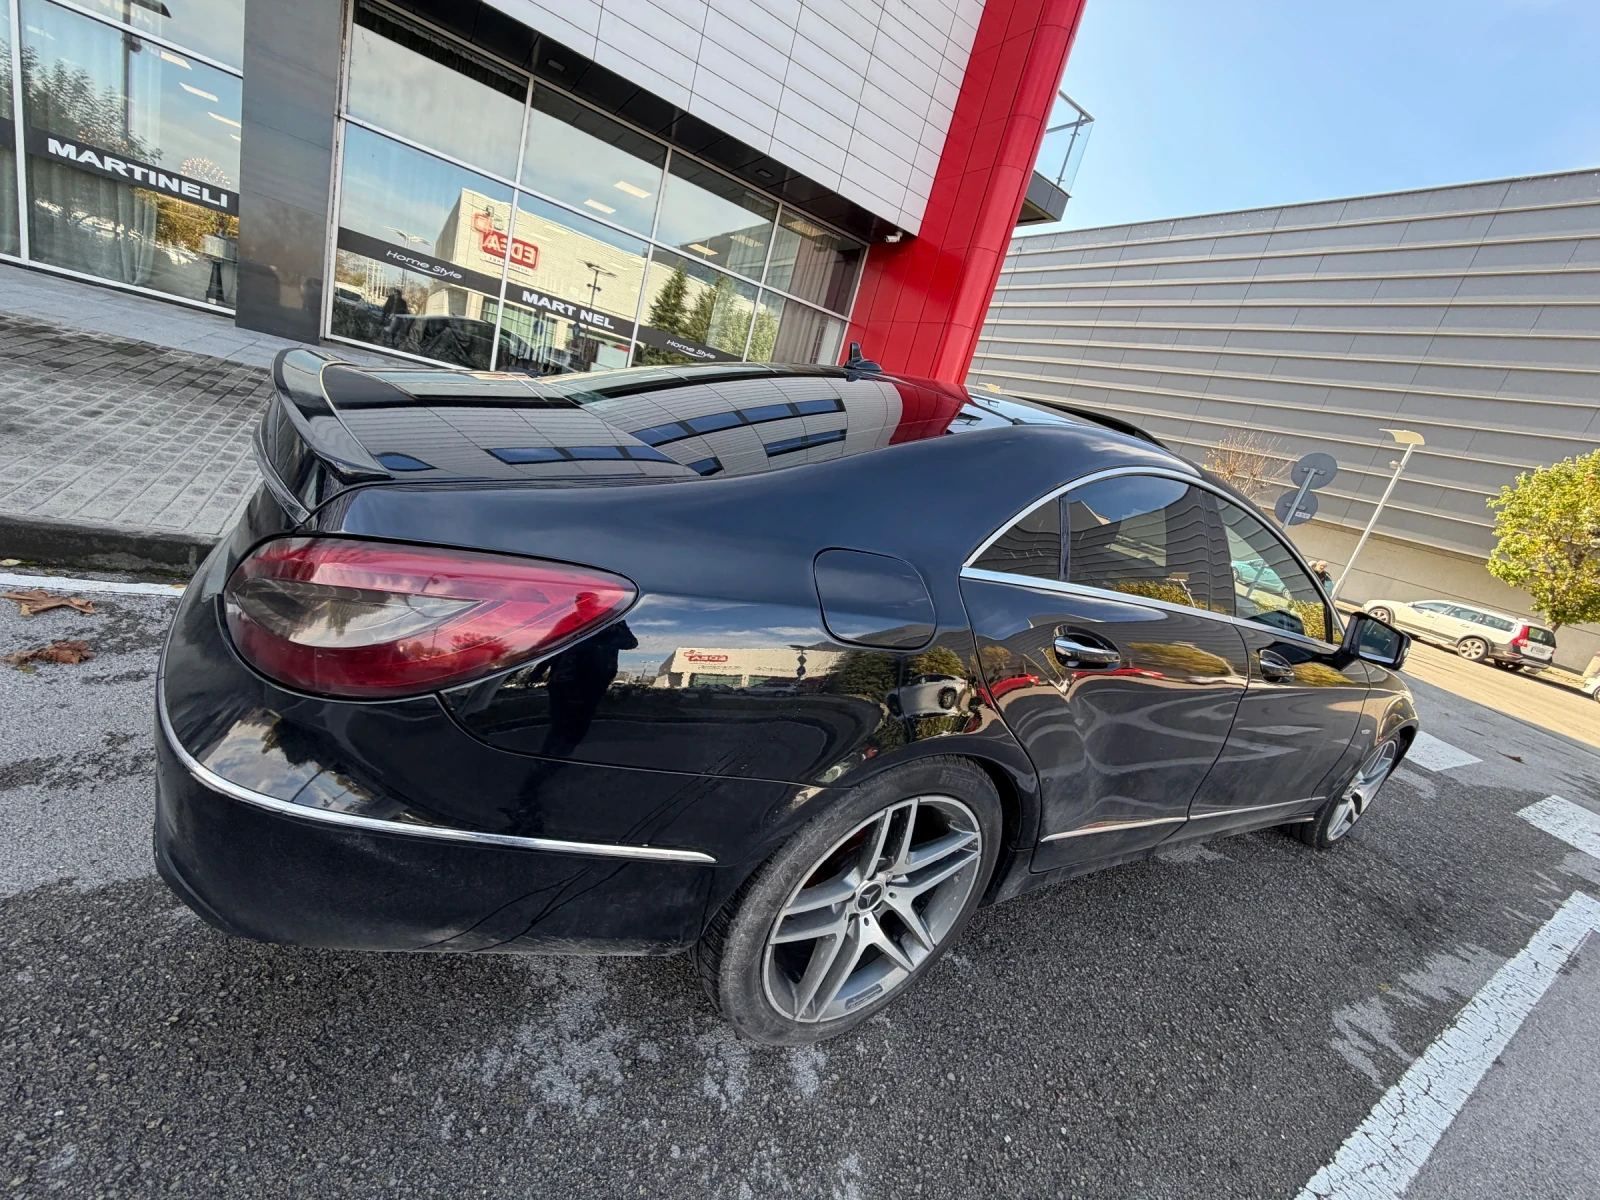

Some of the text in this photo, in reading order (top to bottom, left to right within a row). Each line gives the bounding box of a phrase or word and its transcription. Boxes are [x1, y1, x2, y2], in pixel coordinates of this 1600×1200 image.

[47, 138, 228, 208] MARTINELI
[386, 250, 463, 280] Home Style
[666, 339, 716, 359] Home Style
